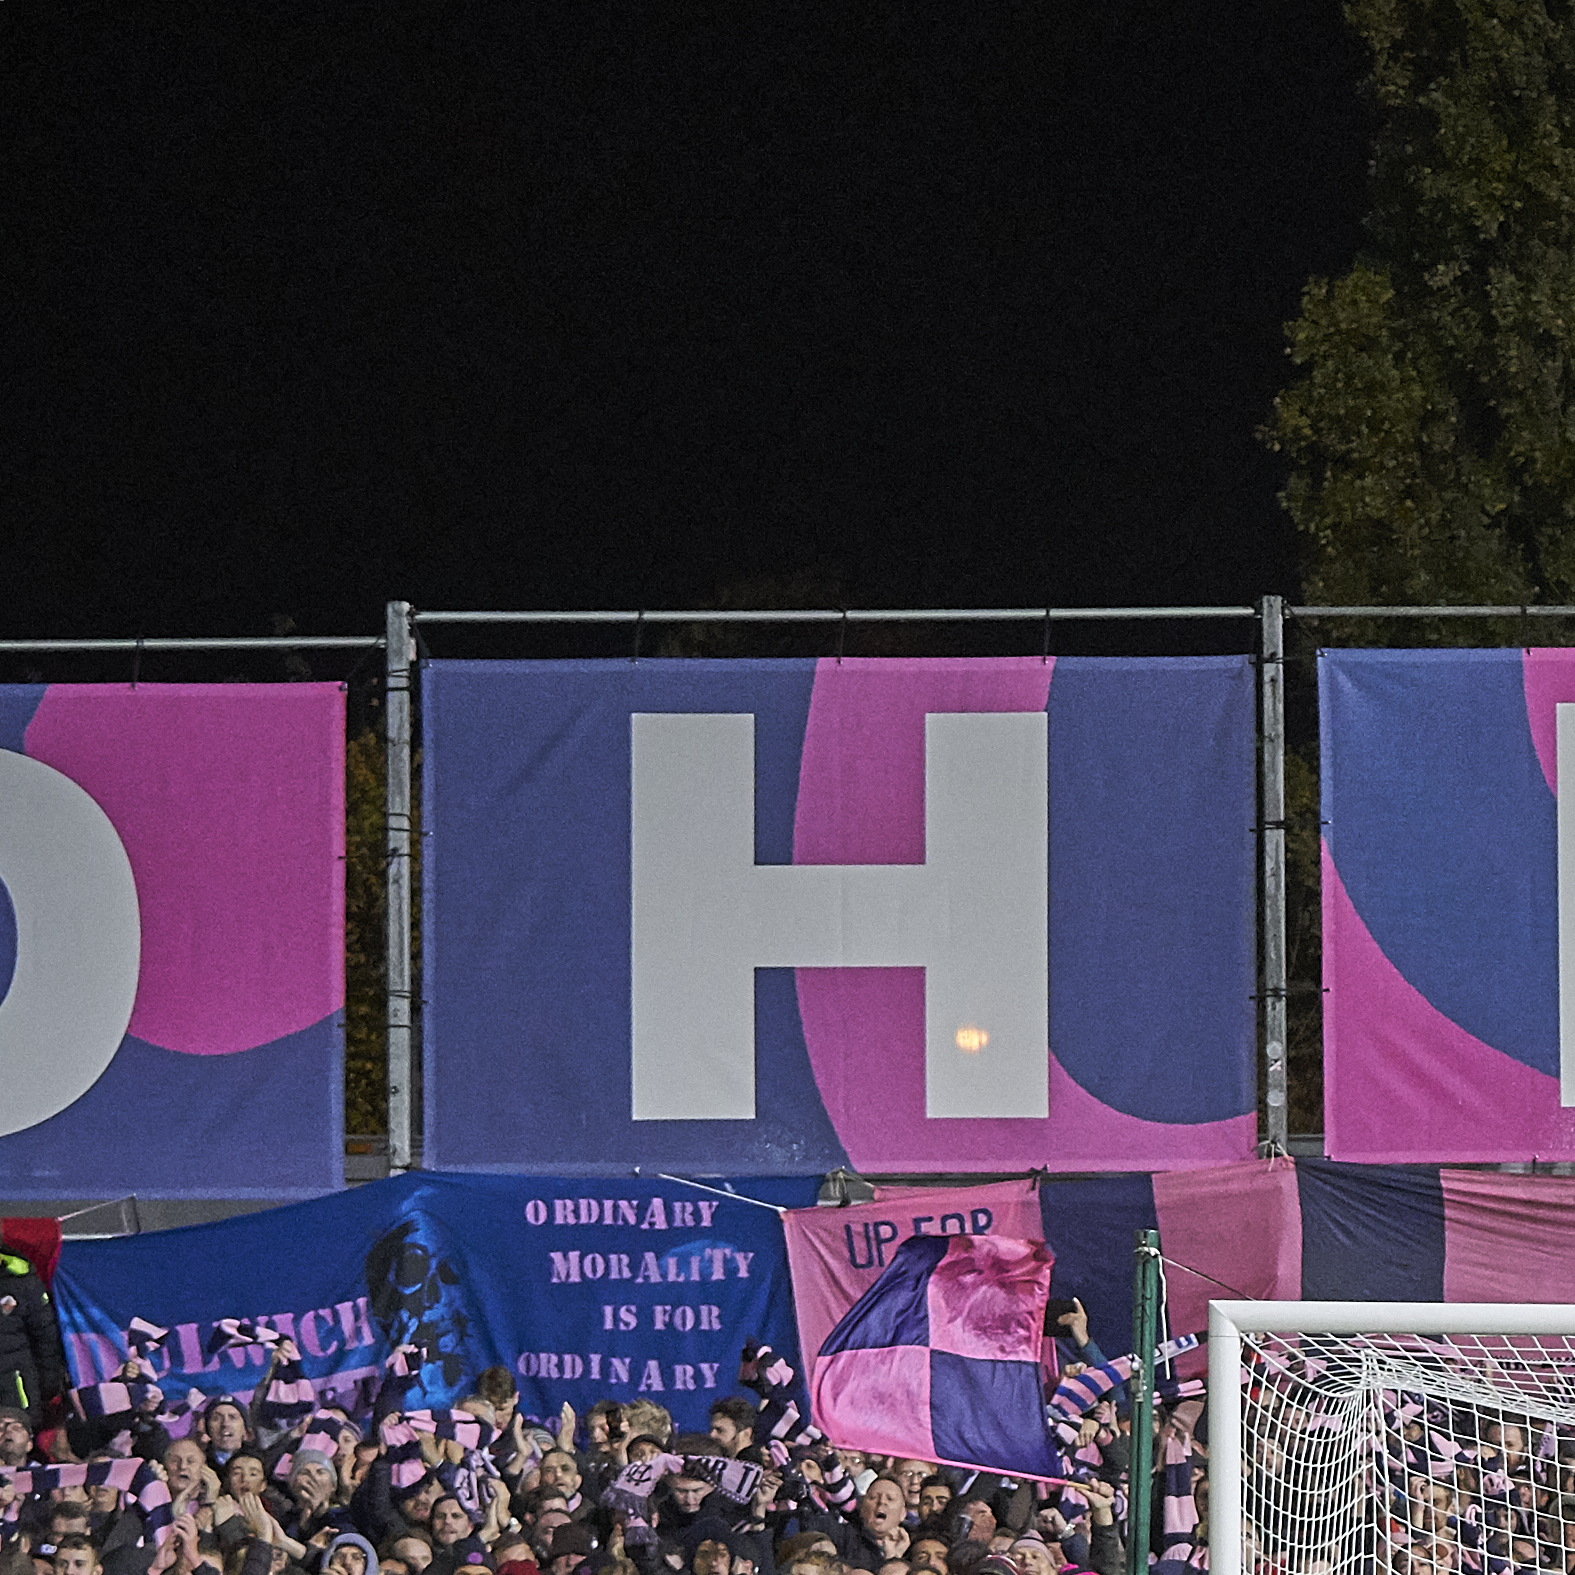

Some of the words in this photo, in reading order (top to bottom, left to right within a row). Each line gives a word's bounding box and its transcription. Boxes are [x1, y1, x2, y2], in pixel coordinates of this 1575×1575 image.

[632, 712, 1049, 1120] H
[525, 1198, 719, 1230] ORDINARY
[844, 1220, 898, 1269] UP
[550, 1248, 754, 1283] MORALITY
[603, 1304, 638, 1331] IS
[653, 1304, 722, 1332] FOR
[517, 1352, 720, 1392] ORDINARY
